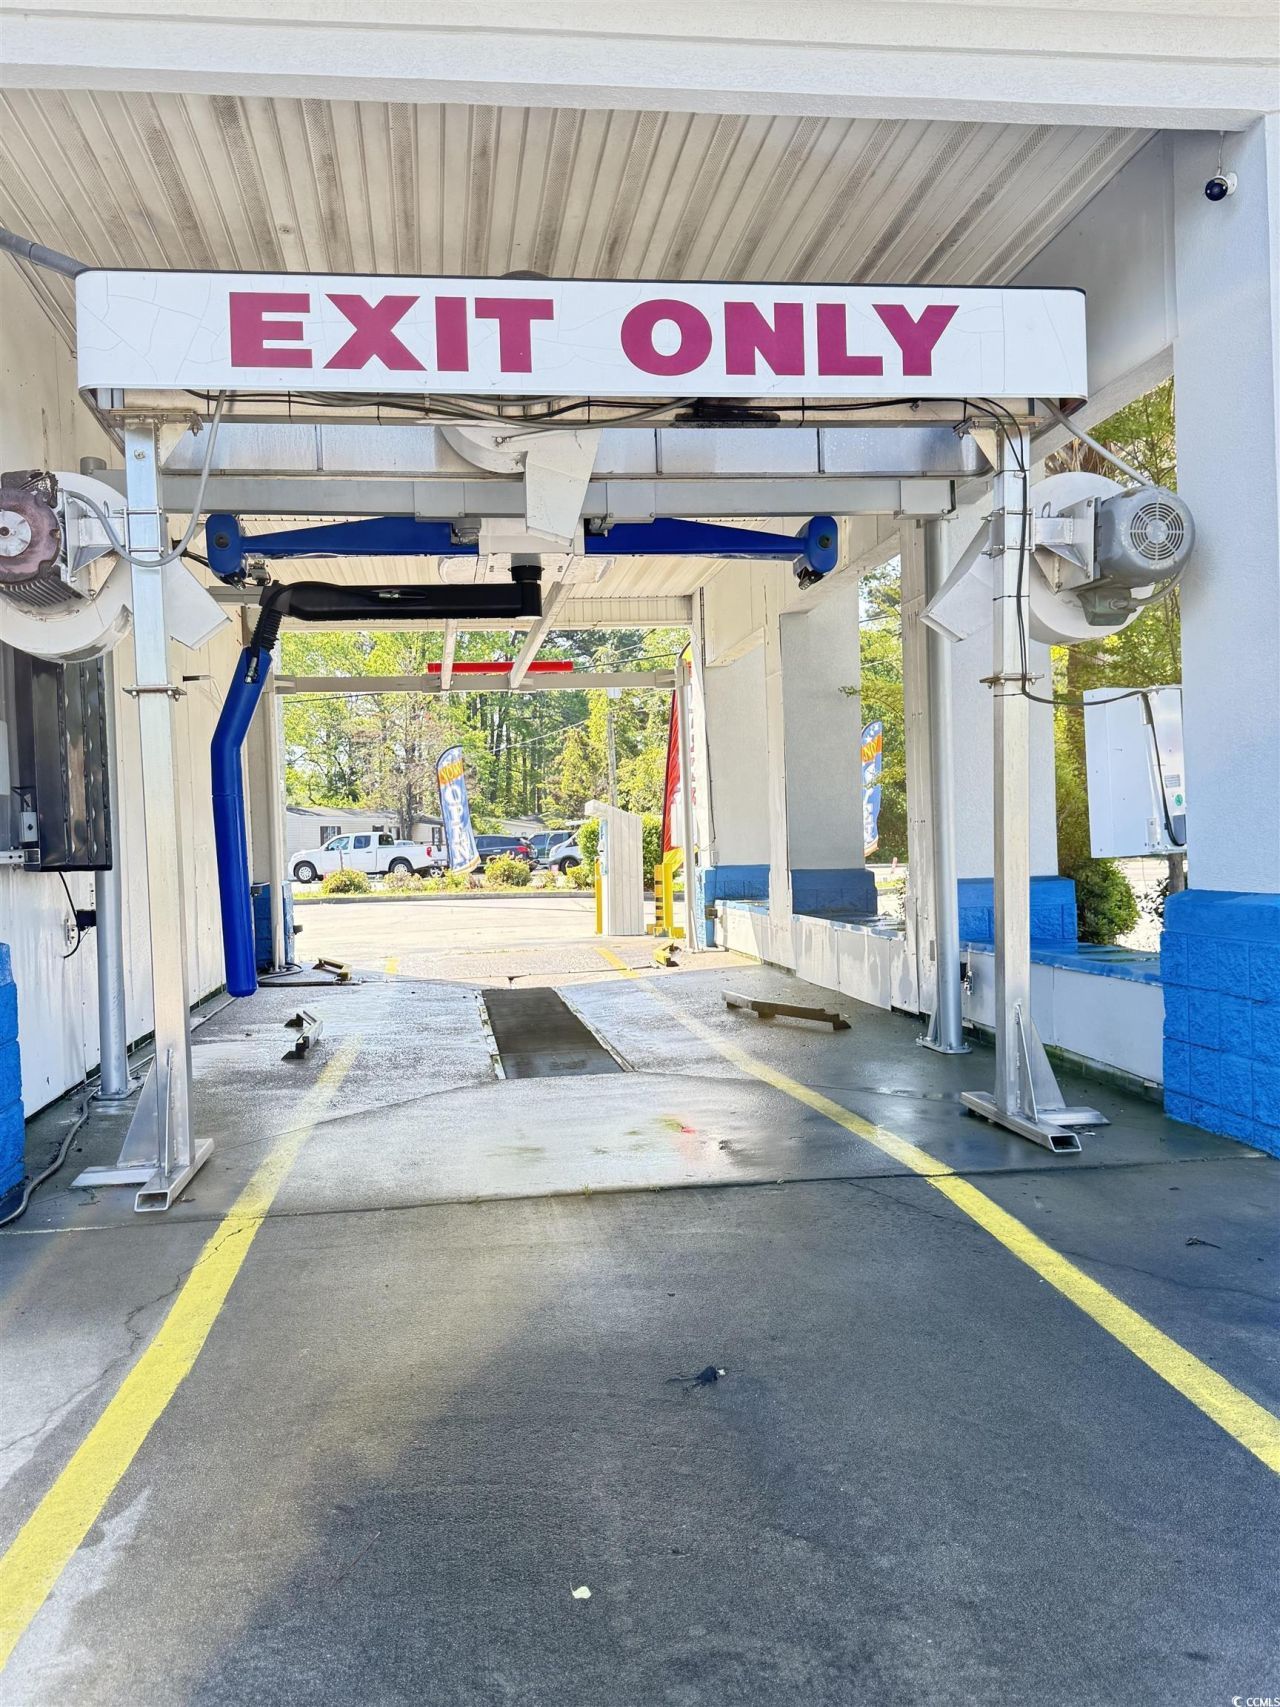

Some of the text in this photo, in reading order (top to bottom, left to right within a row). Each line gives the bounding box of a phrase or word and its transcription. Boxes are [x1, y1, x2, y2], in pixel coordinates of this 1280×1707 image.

[229, 293, 959, 376] EXIT ONLY
[445, 784, 473, 866] OPEN
